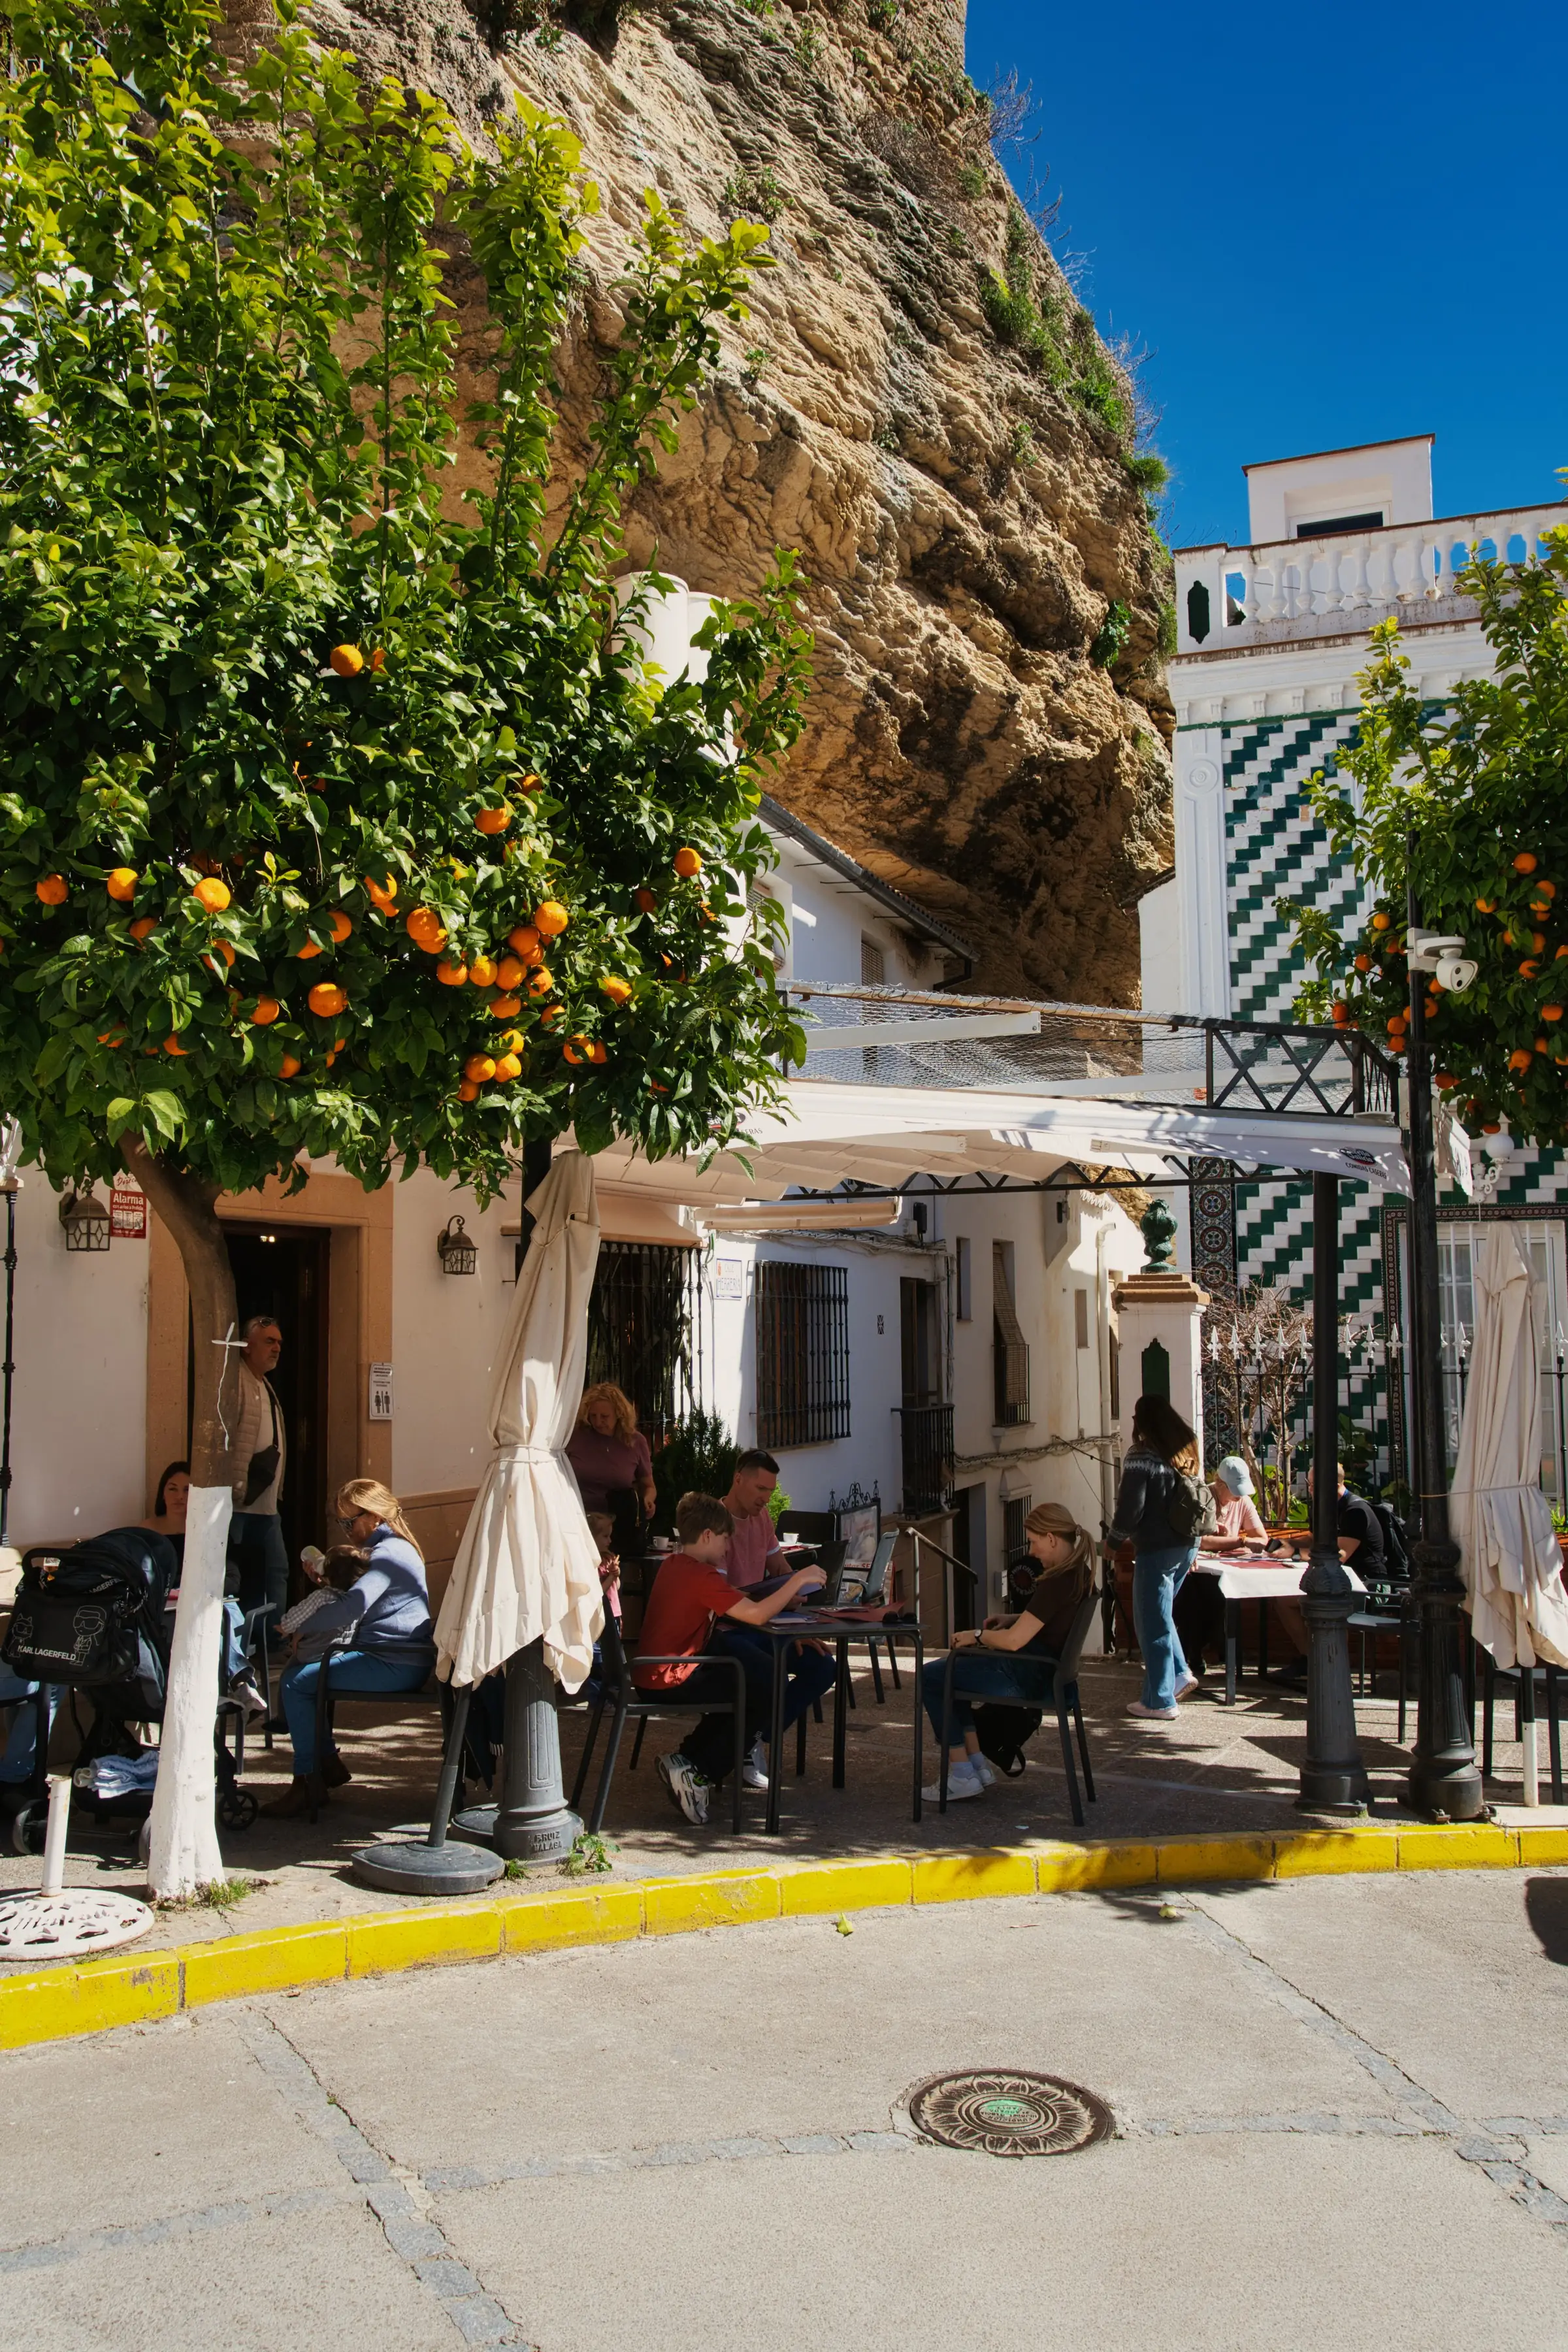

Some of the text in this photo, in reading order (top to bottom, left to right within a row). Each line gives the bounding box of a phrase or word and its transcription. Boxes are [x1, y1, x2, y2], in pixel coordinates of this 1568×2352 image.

[1345, 1162, 1387, 1179] COMIDAS CASERAS
[113, 1193, 144, 1205] Alarma
[18, 1644, 76, 1661] KARL LAGERFELD
